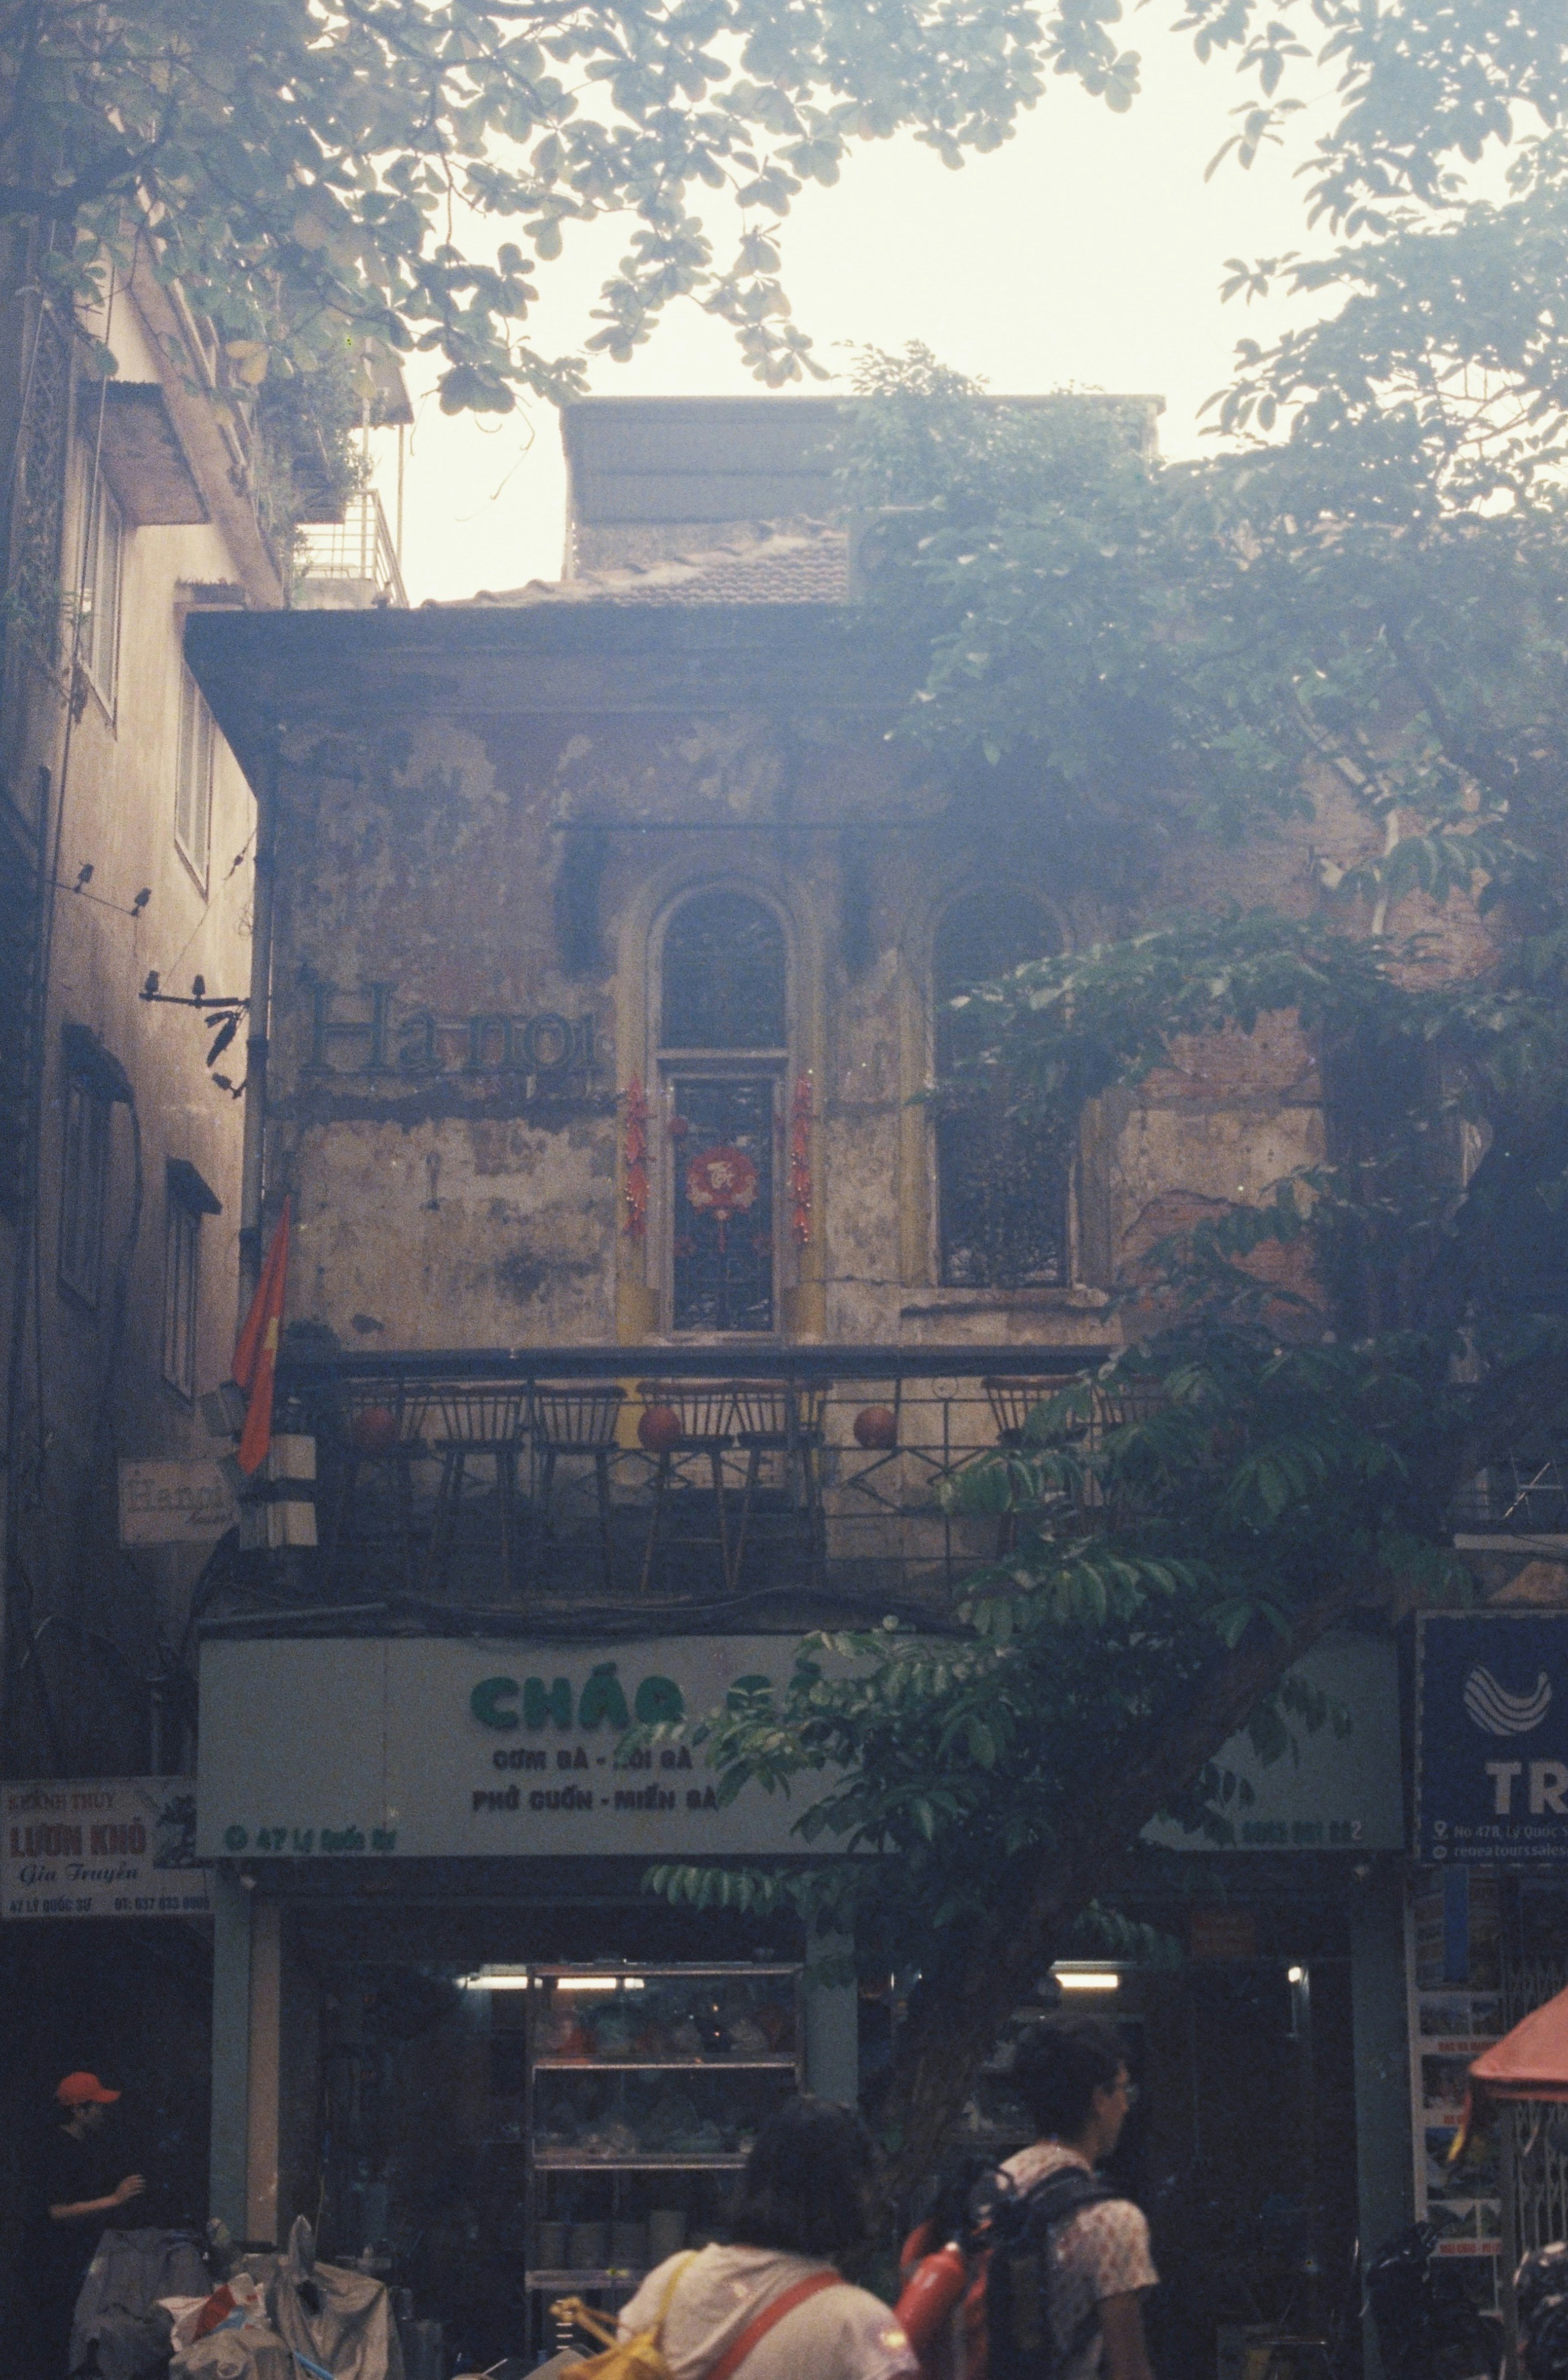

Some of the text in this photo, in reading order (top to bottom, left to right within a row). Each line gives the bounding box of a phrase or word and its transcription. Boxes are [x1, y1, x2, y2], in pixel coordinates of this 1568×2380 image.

[298, 980, 605, 1076] Hanoi
[470, 1662, 684, 1731] CHÁO
[1485, 1761, 1568, 1815] TR
